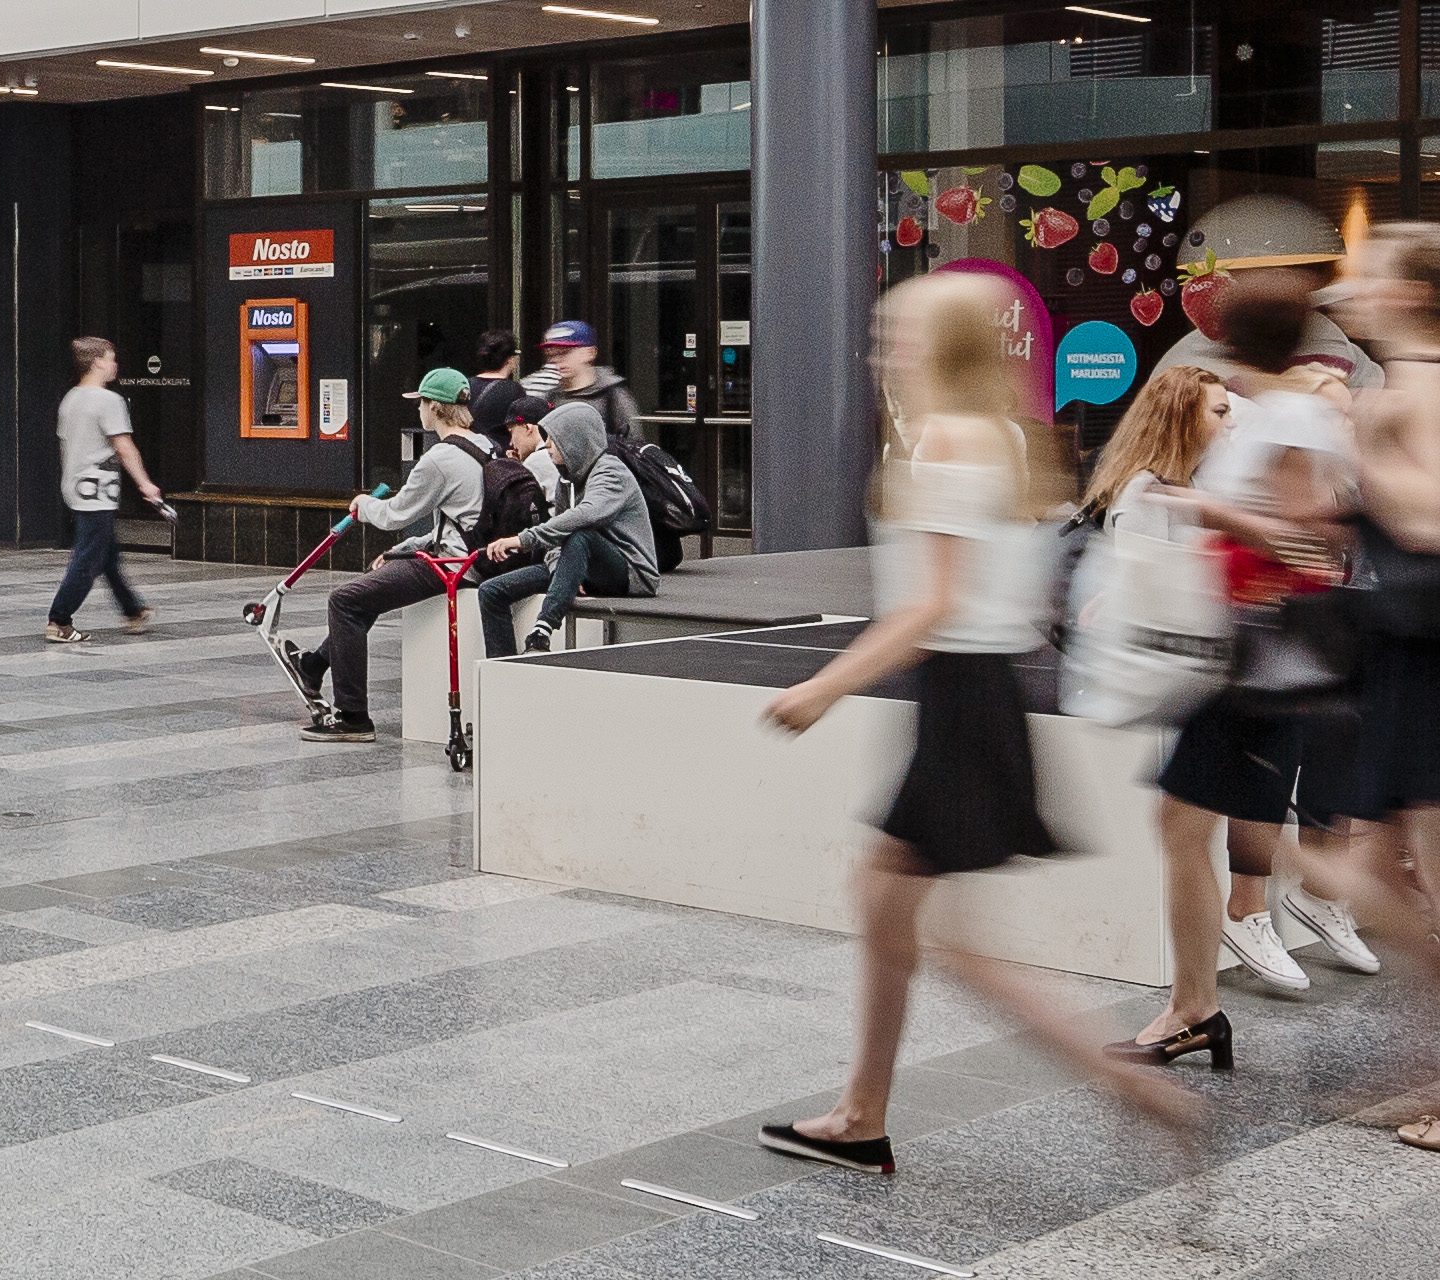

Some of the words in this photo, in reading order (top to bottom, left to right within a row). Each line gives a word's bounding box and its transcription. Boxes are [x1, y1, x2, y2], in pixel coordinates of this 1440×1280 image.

[252, 238, 310, 261] Nosto
[251, 309, 293, 326] Nosto
[1066, 353, 1126, 365] KOTIMAISISTA
